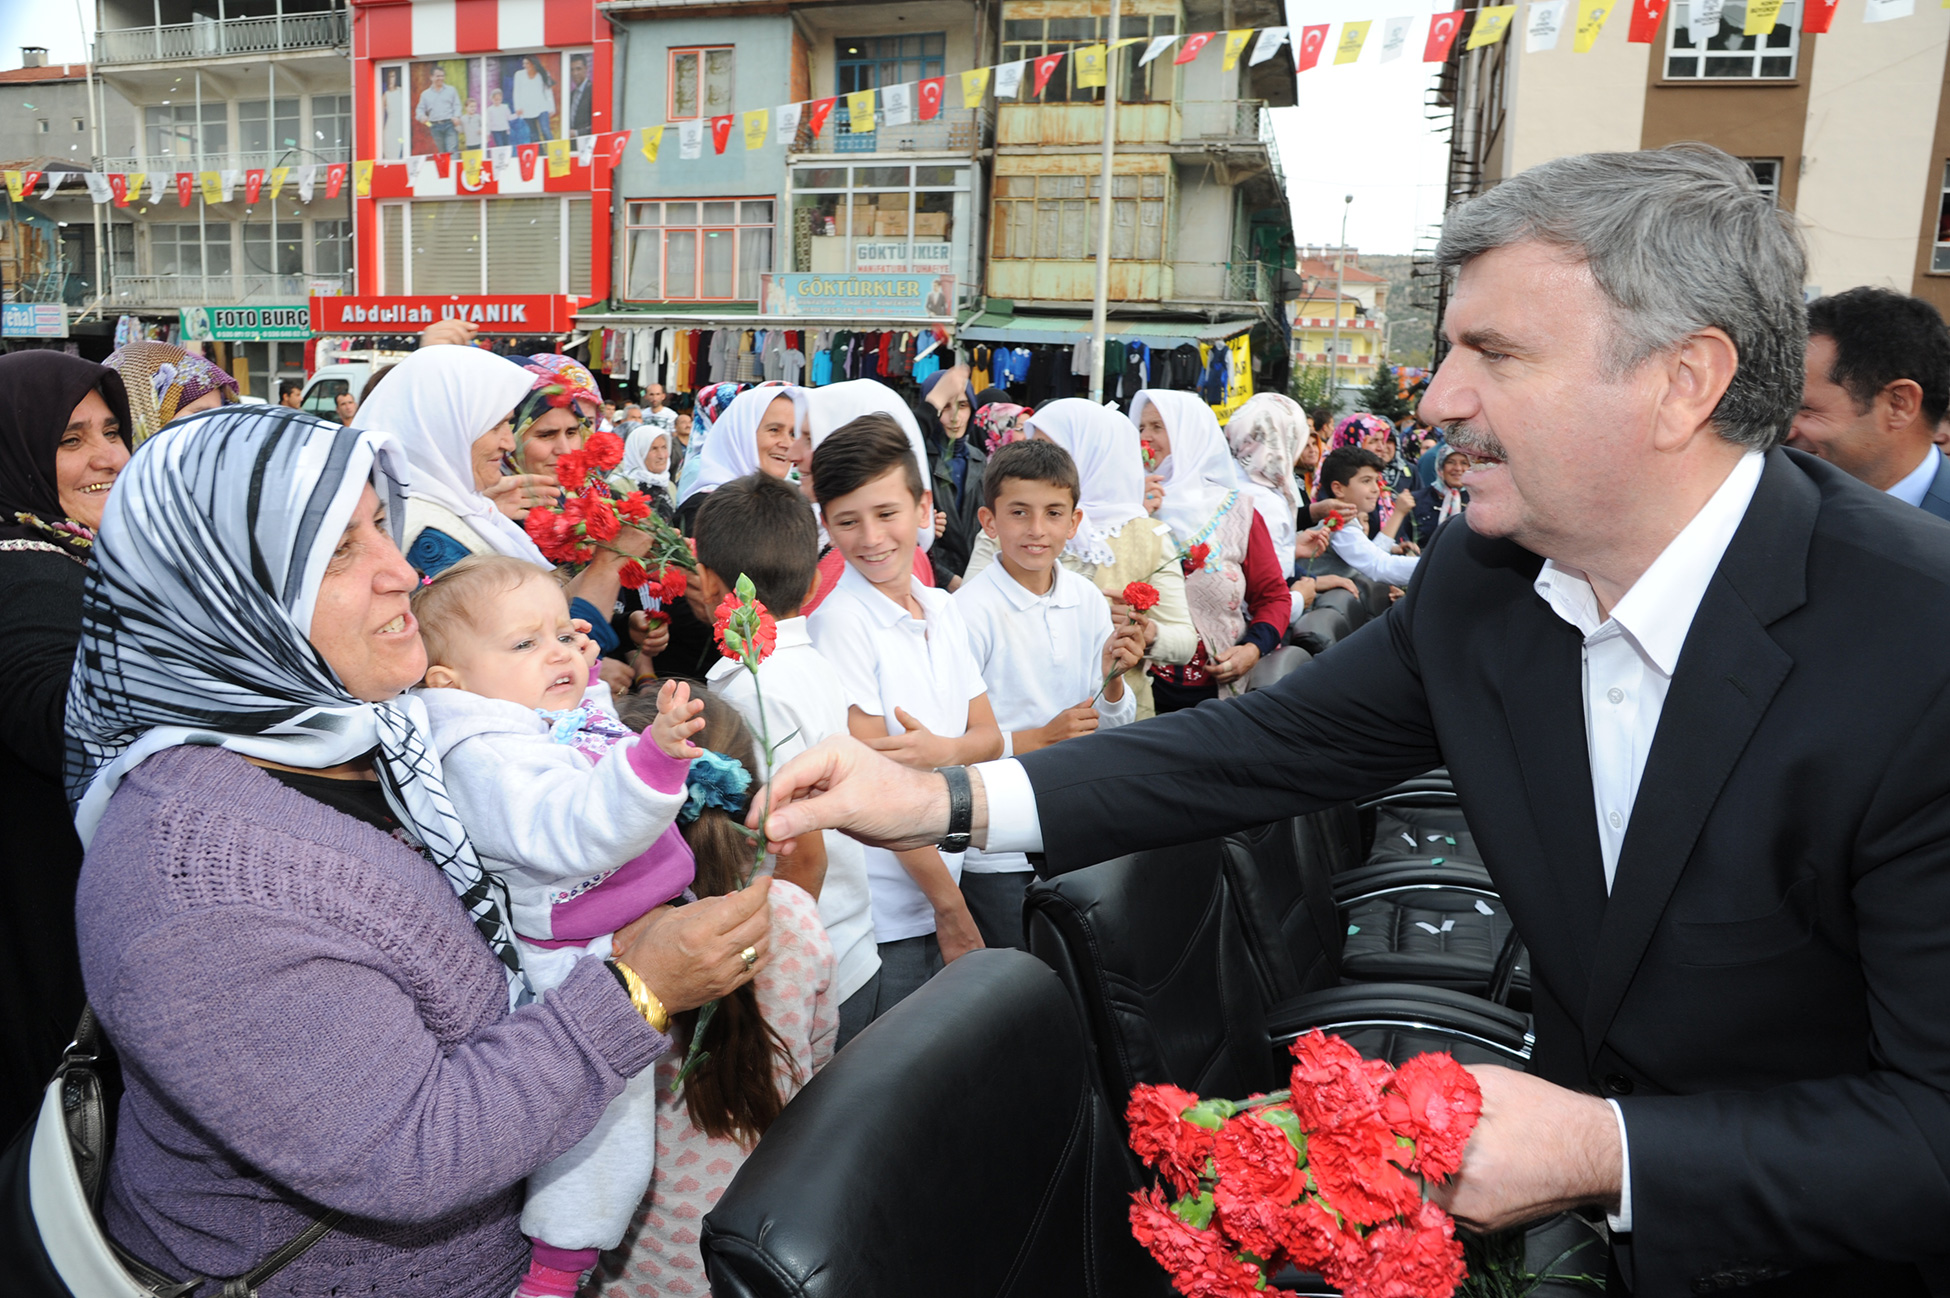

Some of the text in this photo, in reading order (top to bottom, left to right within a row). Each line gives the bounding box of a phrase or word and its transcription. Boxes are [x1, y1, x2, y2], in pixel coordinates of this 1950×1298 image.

[797, 276, 921, 298] GÖKTÜRKLER
[215, 310, 309, 330] FOTO BURÇ
[341, 304, 528, 323] Abdullah UYANIK
